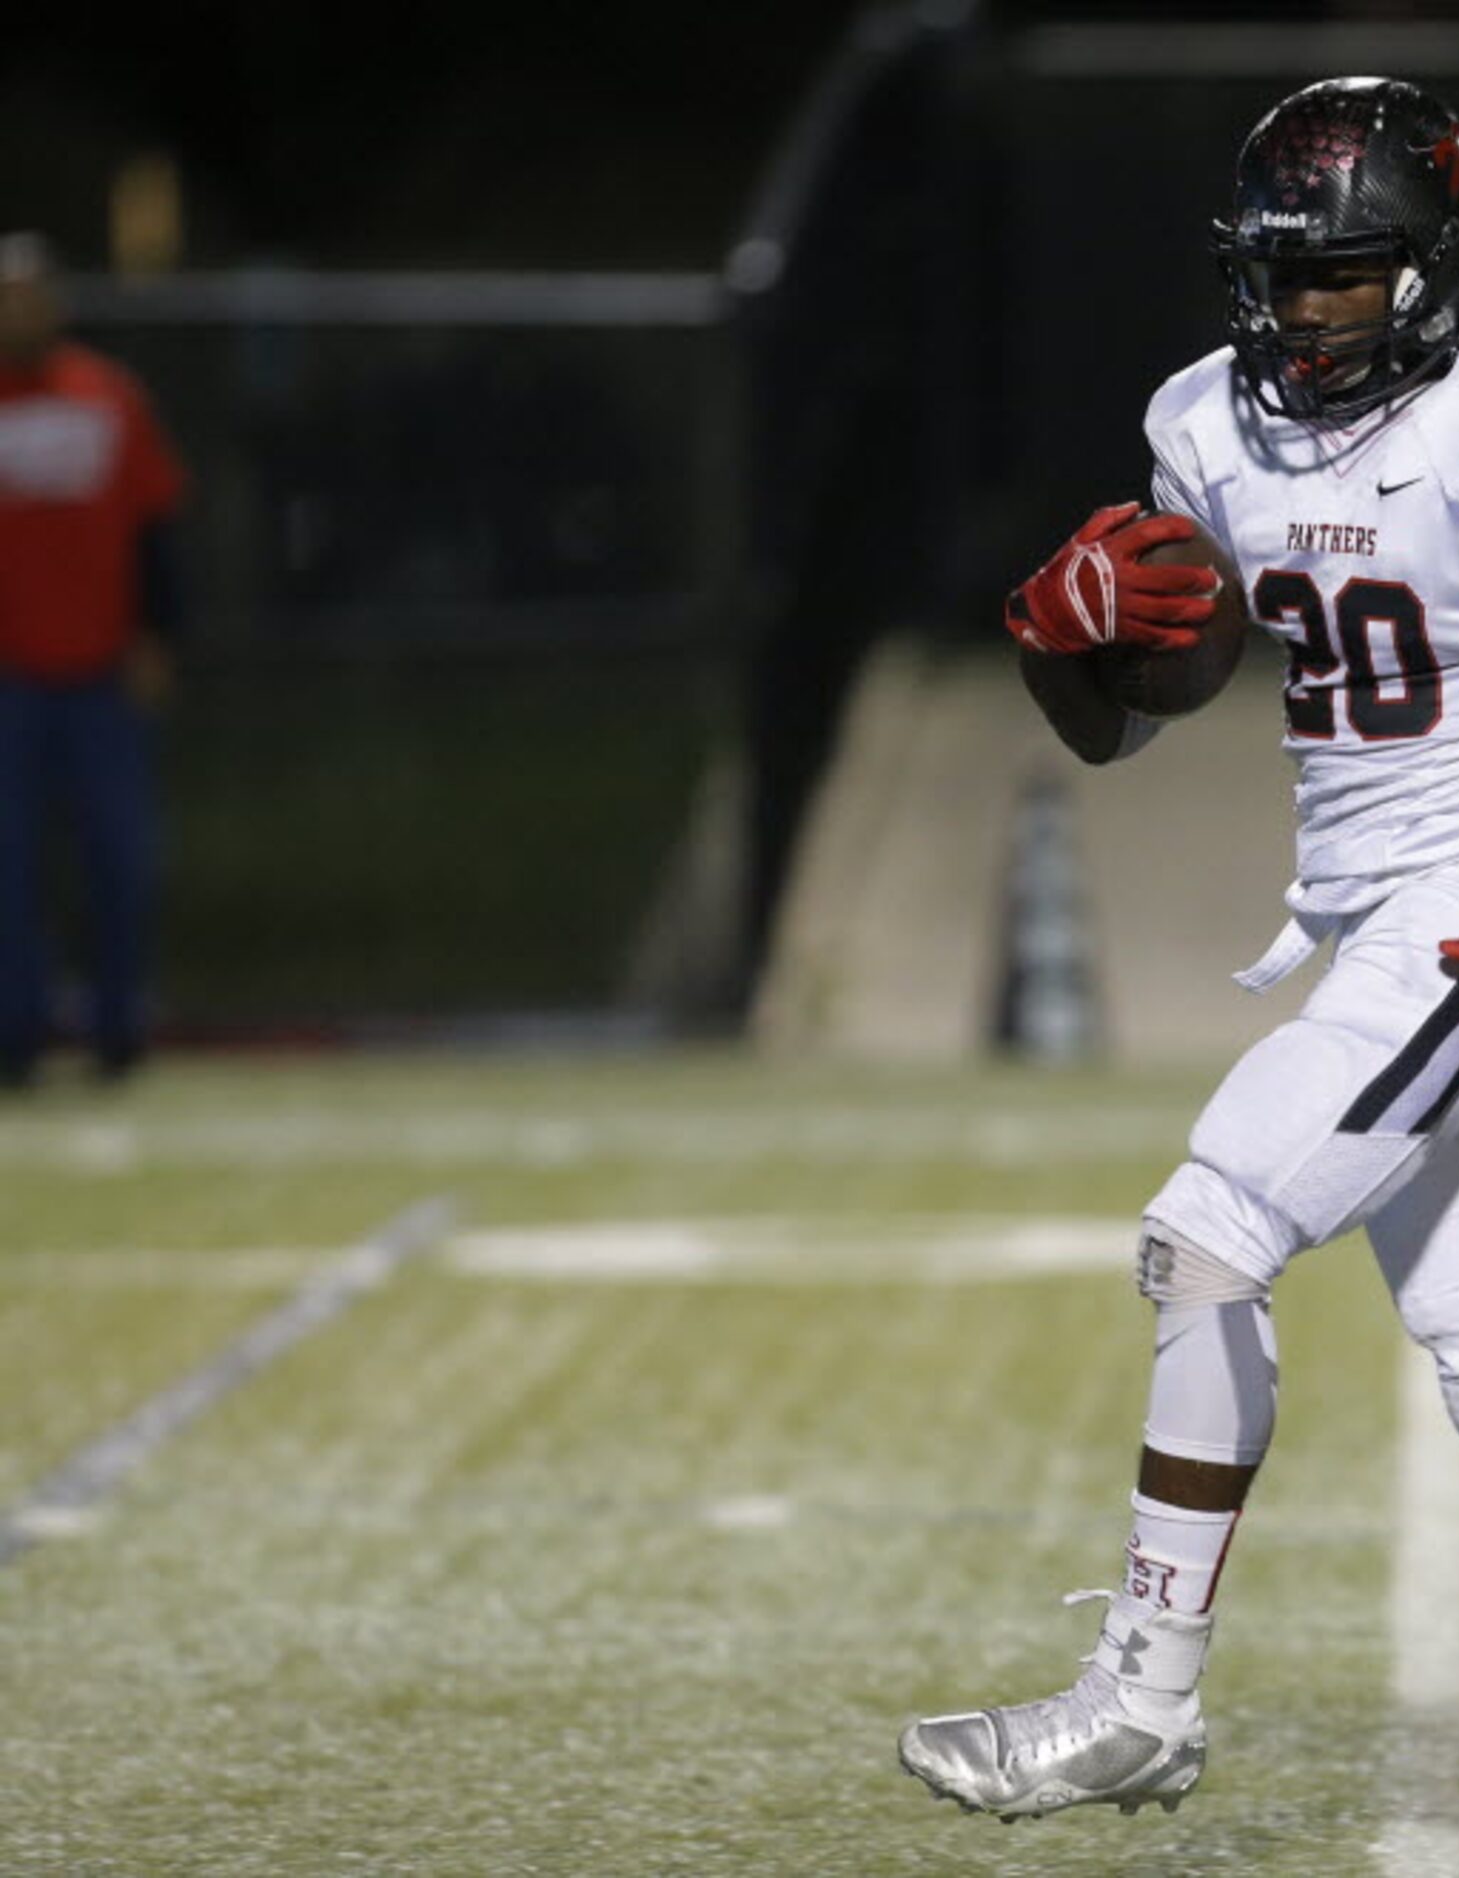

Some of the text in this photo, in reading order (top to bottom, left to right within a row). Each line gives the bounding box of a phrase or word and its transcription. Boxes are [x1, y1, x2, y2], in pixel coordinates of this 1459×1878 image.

[1262, 209, 1306, 229] Riddell
[1286, 522, 1378, 557] PANTHERS
[1252, 568, 1443, 742] 20
